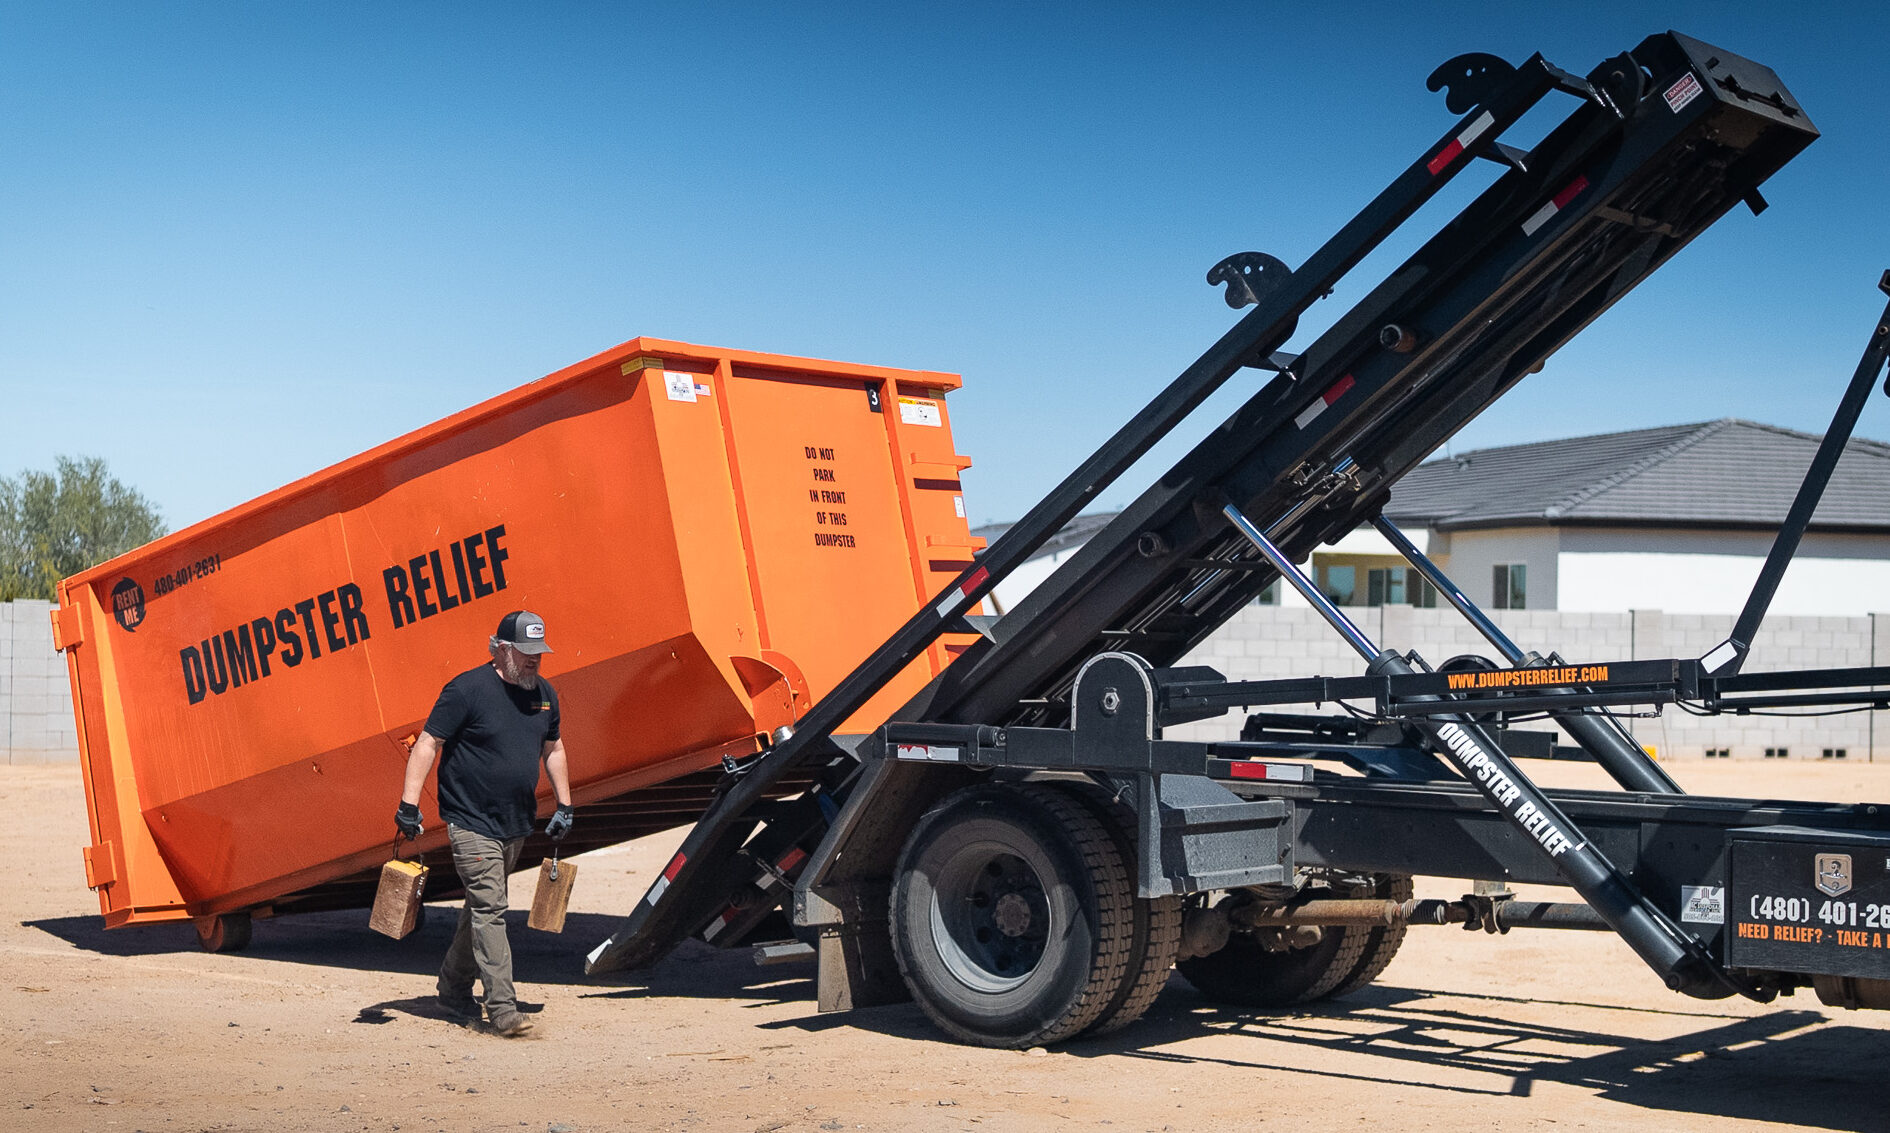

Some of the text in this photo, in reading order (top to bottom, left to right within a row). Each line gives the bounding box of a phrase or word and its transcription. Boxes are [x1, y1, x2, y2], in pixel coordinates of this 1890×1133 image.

[1669, 78, 1690, 97] DANGER
[870, 390, 878, 406] 3
[805, 447, 835, 461] DO NOT
[813, 469, 835, 482] PARK
[809, 490, 846, 504] IN FRONT
[816, 512, 847, 526] OF THIS
[814, 534, 856, 548] DUMPSTER
[154, 554, 221, 596] 480-401-2631
[116, 587, 140, 610] RENT
[123, 607, 139, 626] ME
[180, 524, 510, 705] DUMPSTER RELIEF
[1448, 666, 1609, 690] WWW.DUMPSTERRELIEF.COM
[1436, 722, 1574, 858] DUMPSTER RELIEF
[1750, 894, 1810, 923] (480)
[1738, 922, 1769, 940] NEED
[1773, 925, 1823, 943] RELIEF?
[1836, 930, 1869, 947] TAKE
[1872, 932, 1882, 948] A
